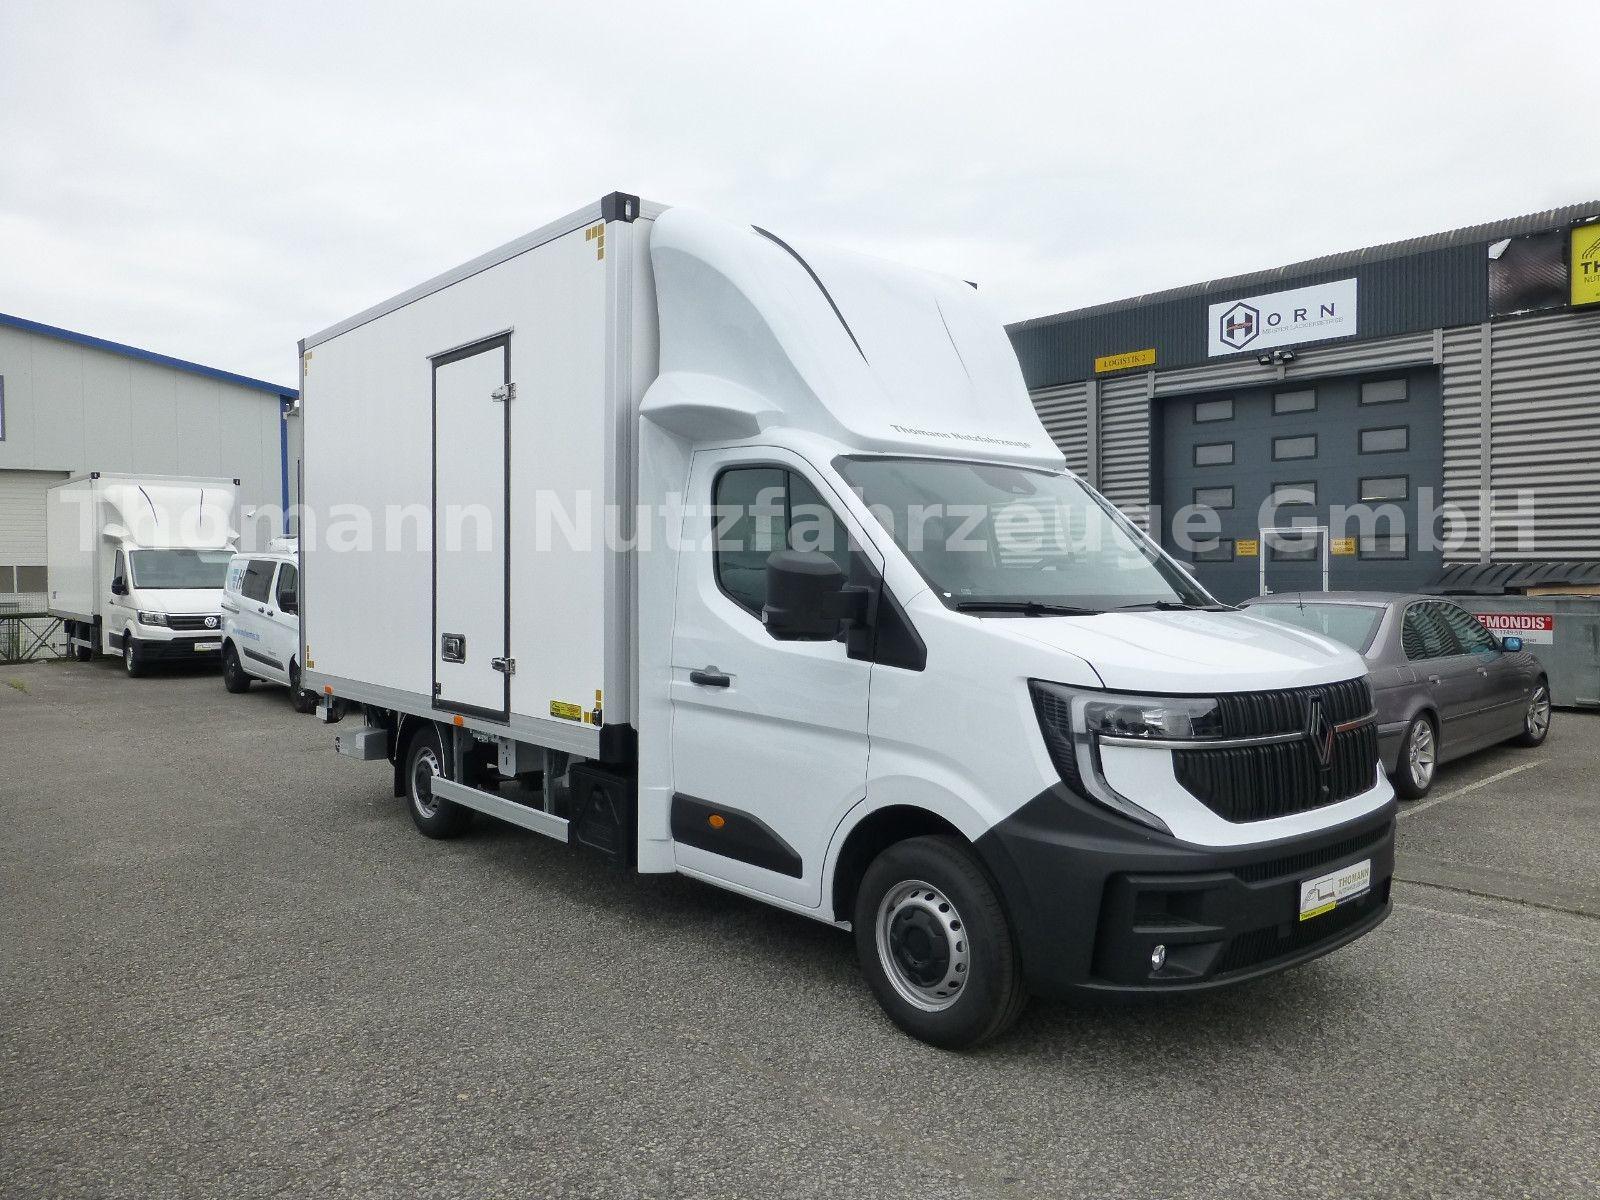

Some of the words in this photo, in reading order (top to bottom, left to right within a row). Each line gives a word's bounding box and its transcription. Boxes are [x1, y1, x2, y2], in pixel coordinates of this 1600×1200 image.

[1104, 355, 1139, 368] LOGISTIK
[890, 424, 951, 439] Thomann
[950, 432, 1032, 449] Nutzfahrzeuge
[1475, 615, 1545, 630] EMONDIS
